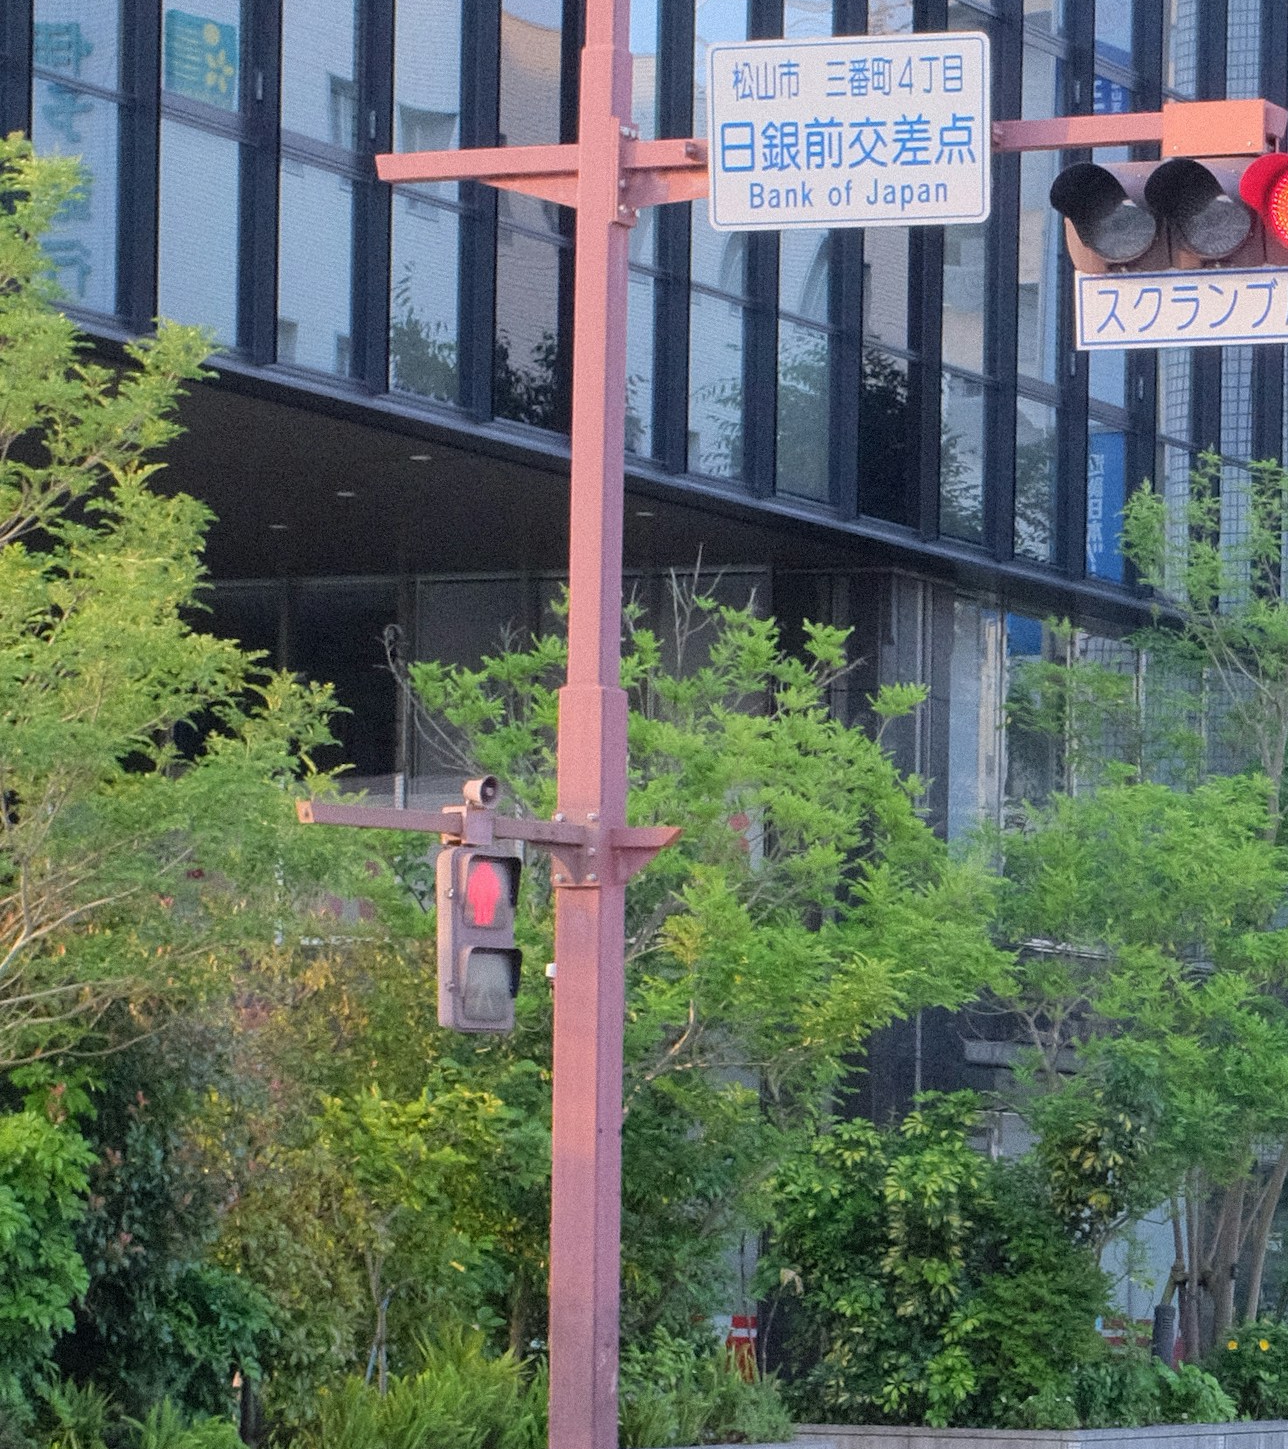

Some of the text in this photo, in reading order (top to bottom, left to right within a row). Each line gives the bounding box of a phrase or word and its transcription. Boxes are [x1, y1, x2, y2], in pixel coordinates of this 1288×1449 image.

[731, 54, 964, 104] 松山市 三番町4丁目
[720, 112, 977, 174] 日銀前交差点
[749, 179, 949, 212] Bank of Japan
